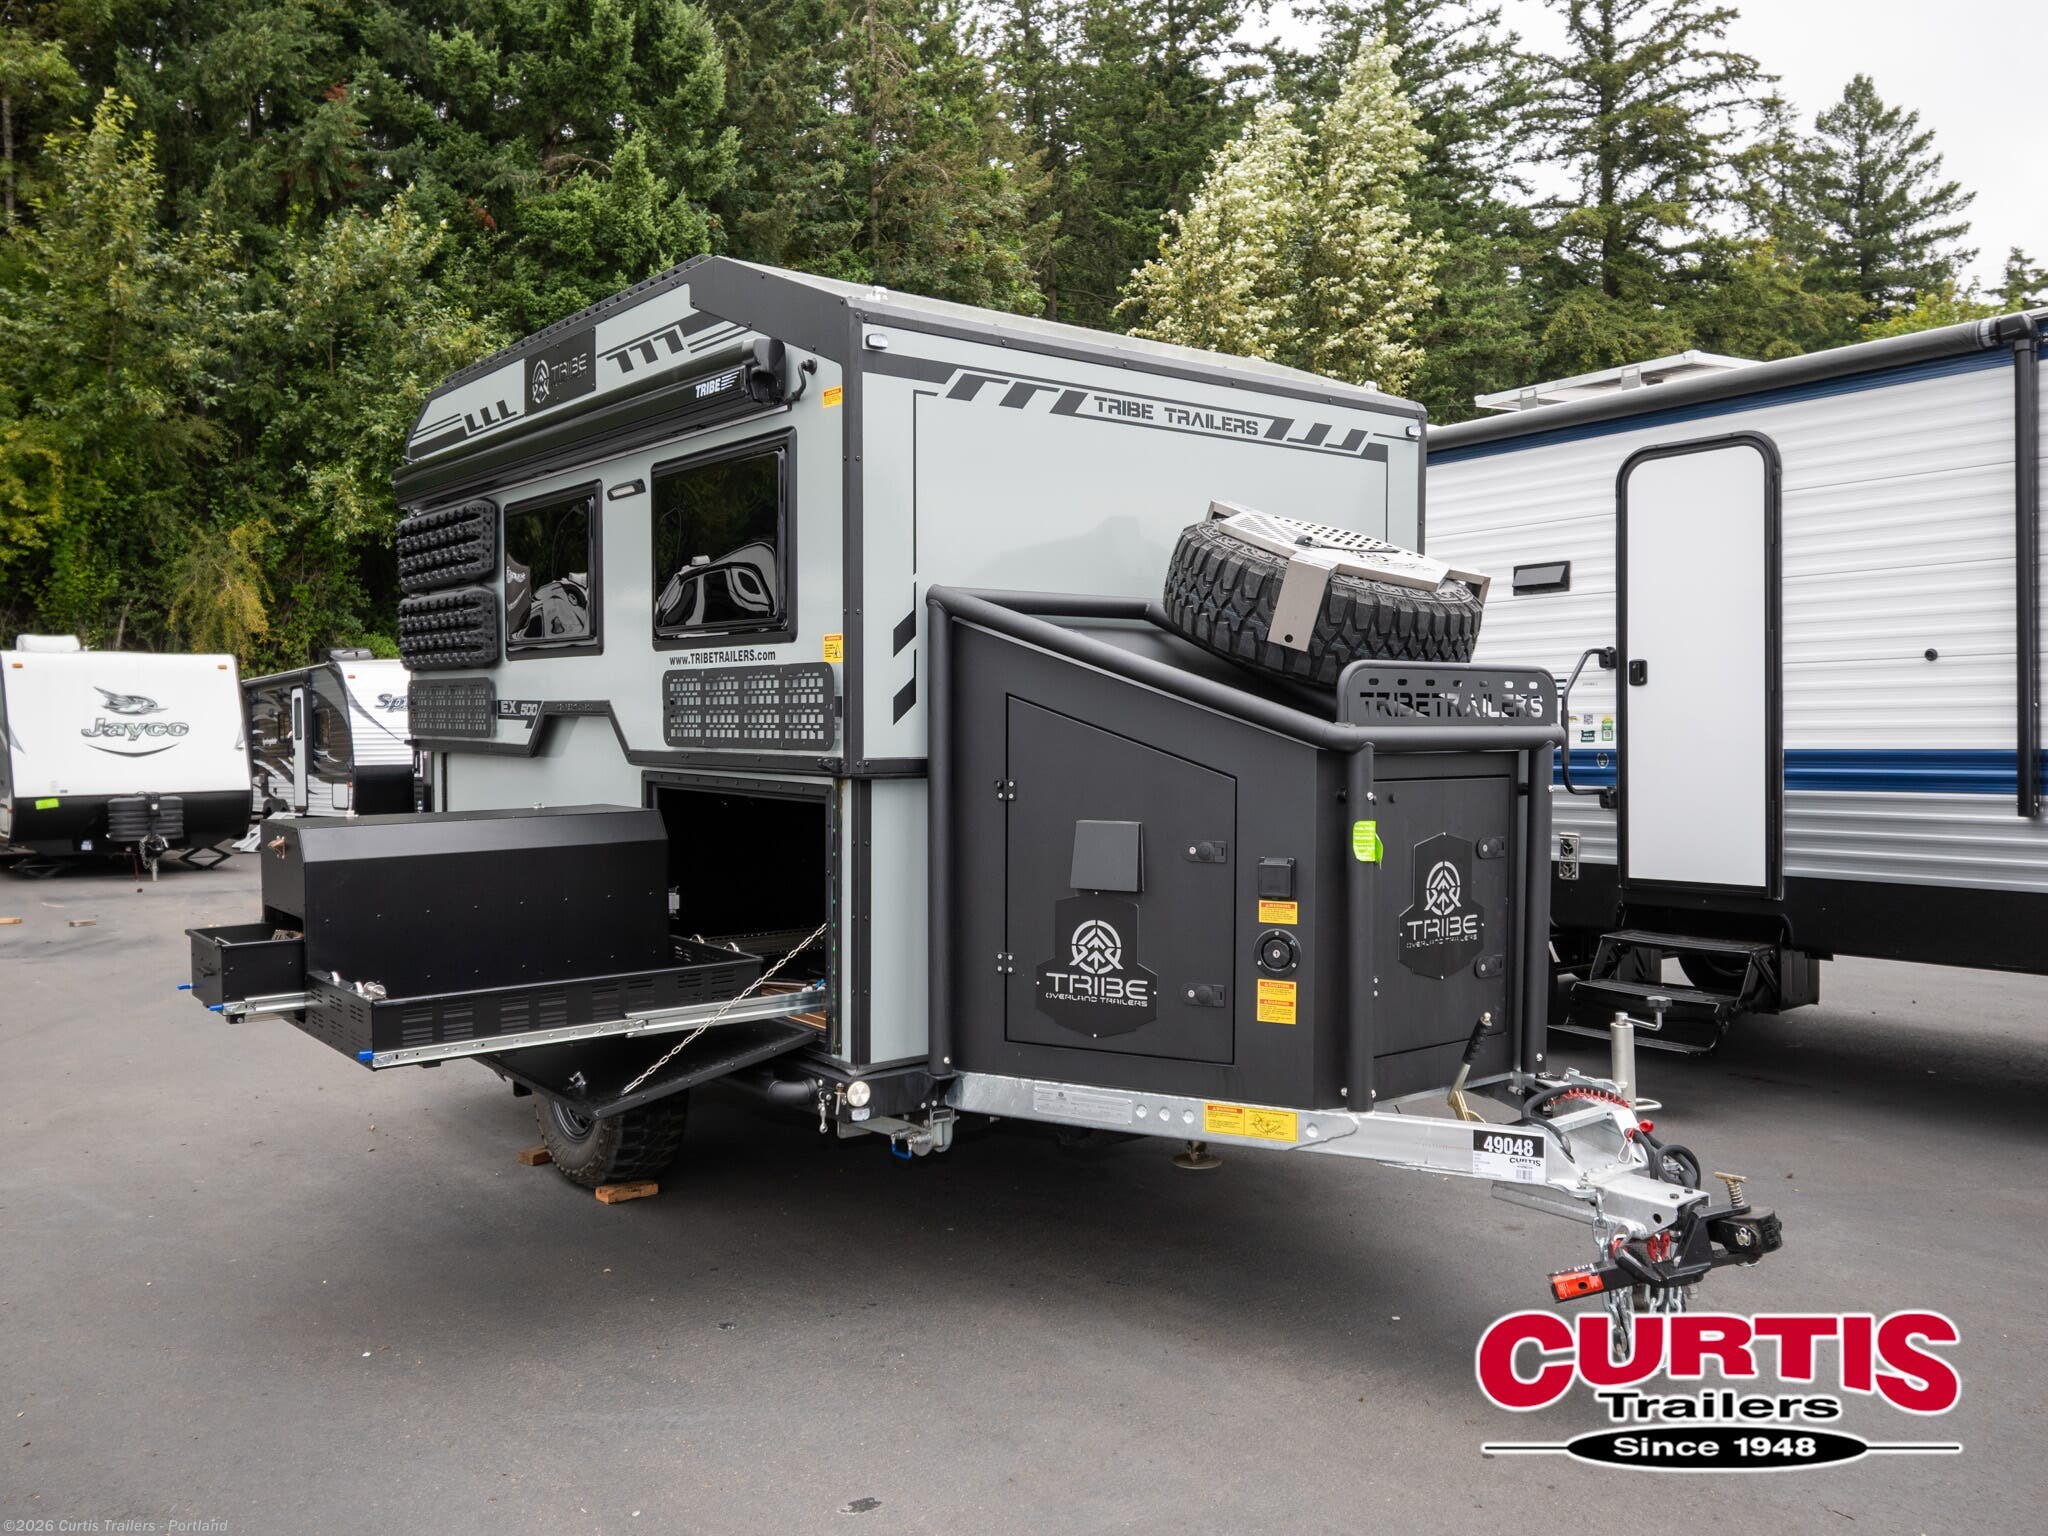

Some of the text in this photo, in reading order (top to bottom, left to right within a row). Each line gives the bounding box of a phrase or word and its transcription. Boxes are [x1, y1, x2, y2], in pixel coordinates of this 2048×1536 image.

[551, 353, 587, 381] TRIBE
[695, 378, 722, 398] TRIBE
[1094, 396, 1259, 436] TRIBE TRAILERS
[669, 649, 776, 665] www.TRIBETRAILERS.com
[501, 700, 538, 716] EX 500
[1360, 692, 1543, 718] TRIBETRAILERS
[81, 717, 189, 741] Jayco
[1406, 914, 1478, 940] TRIBE
[1046, 972, 1148, 1000] TRIBE
[1045, 992, 1148, 1007] OVERLAND TRAILERS
[1483, 1135, 1534, 1157] 49048
[1509, 1157, 1541, 1167] CURTIS
